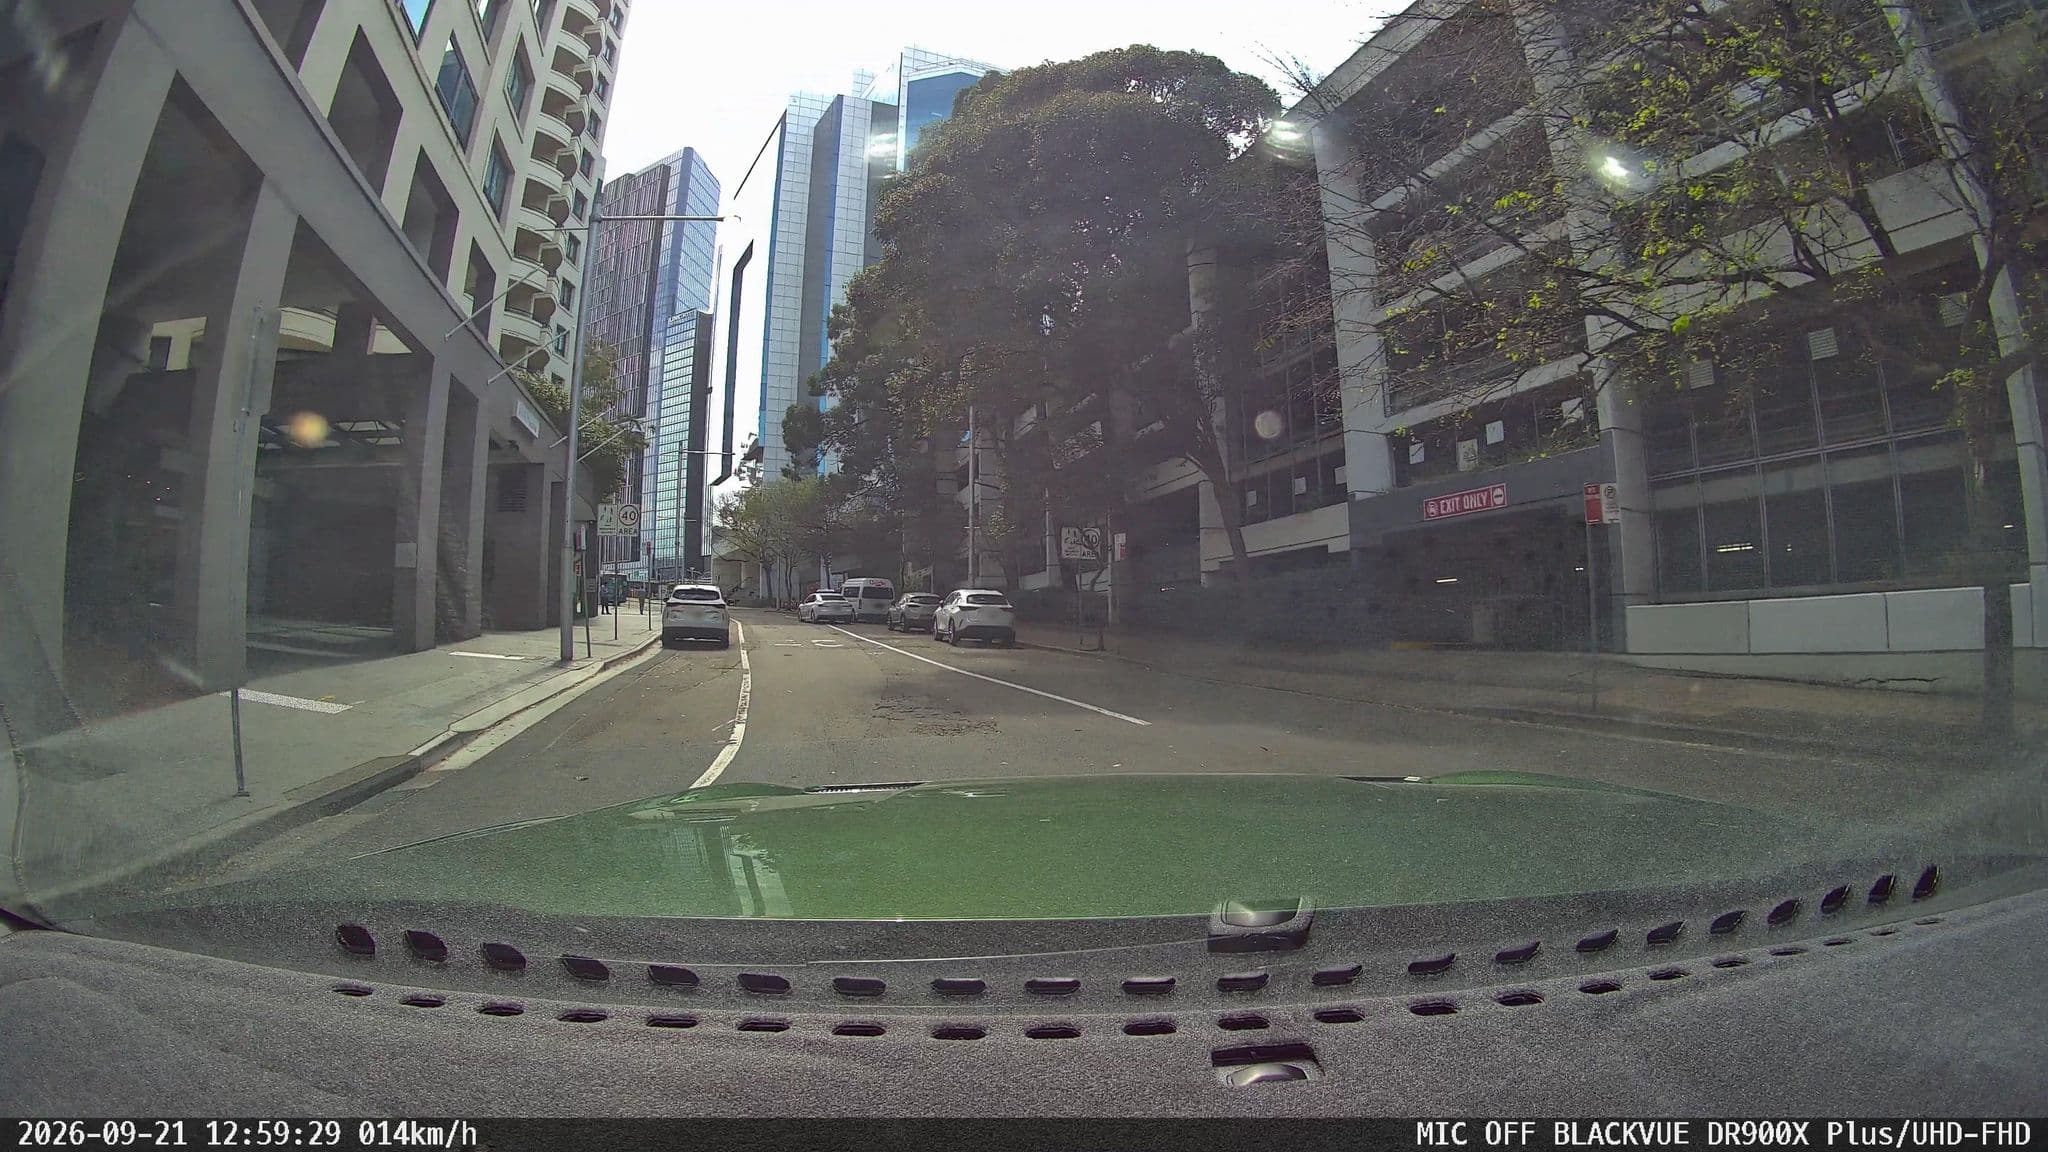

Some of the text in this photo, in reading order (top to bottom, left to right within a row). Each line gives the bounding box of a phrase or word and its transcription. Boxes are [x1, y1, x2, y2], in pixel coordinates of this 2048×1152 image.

[1440, 491, 1488, 514] EXIT ONLY
[621, 511, 636, 520] 40
